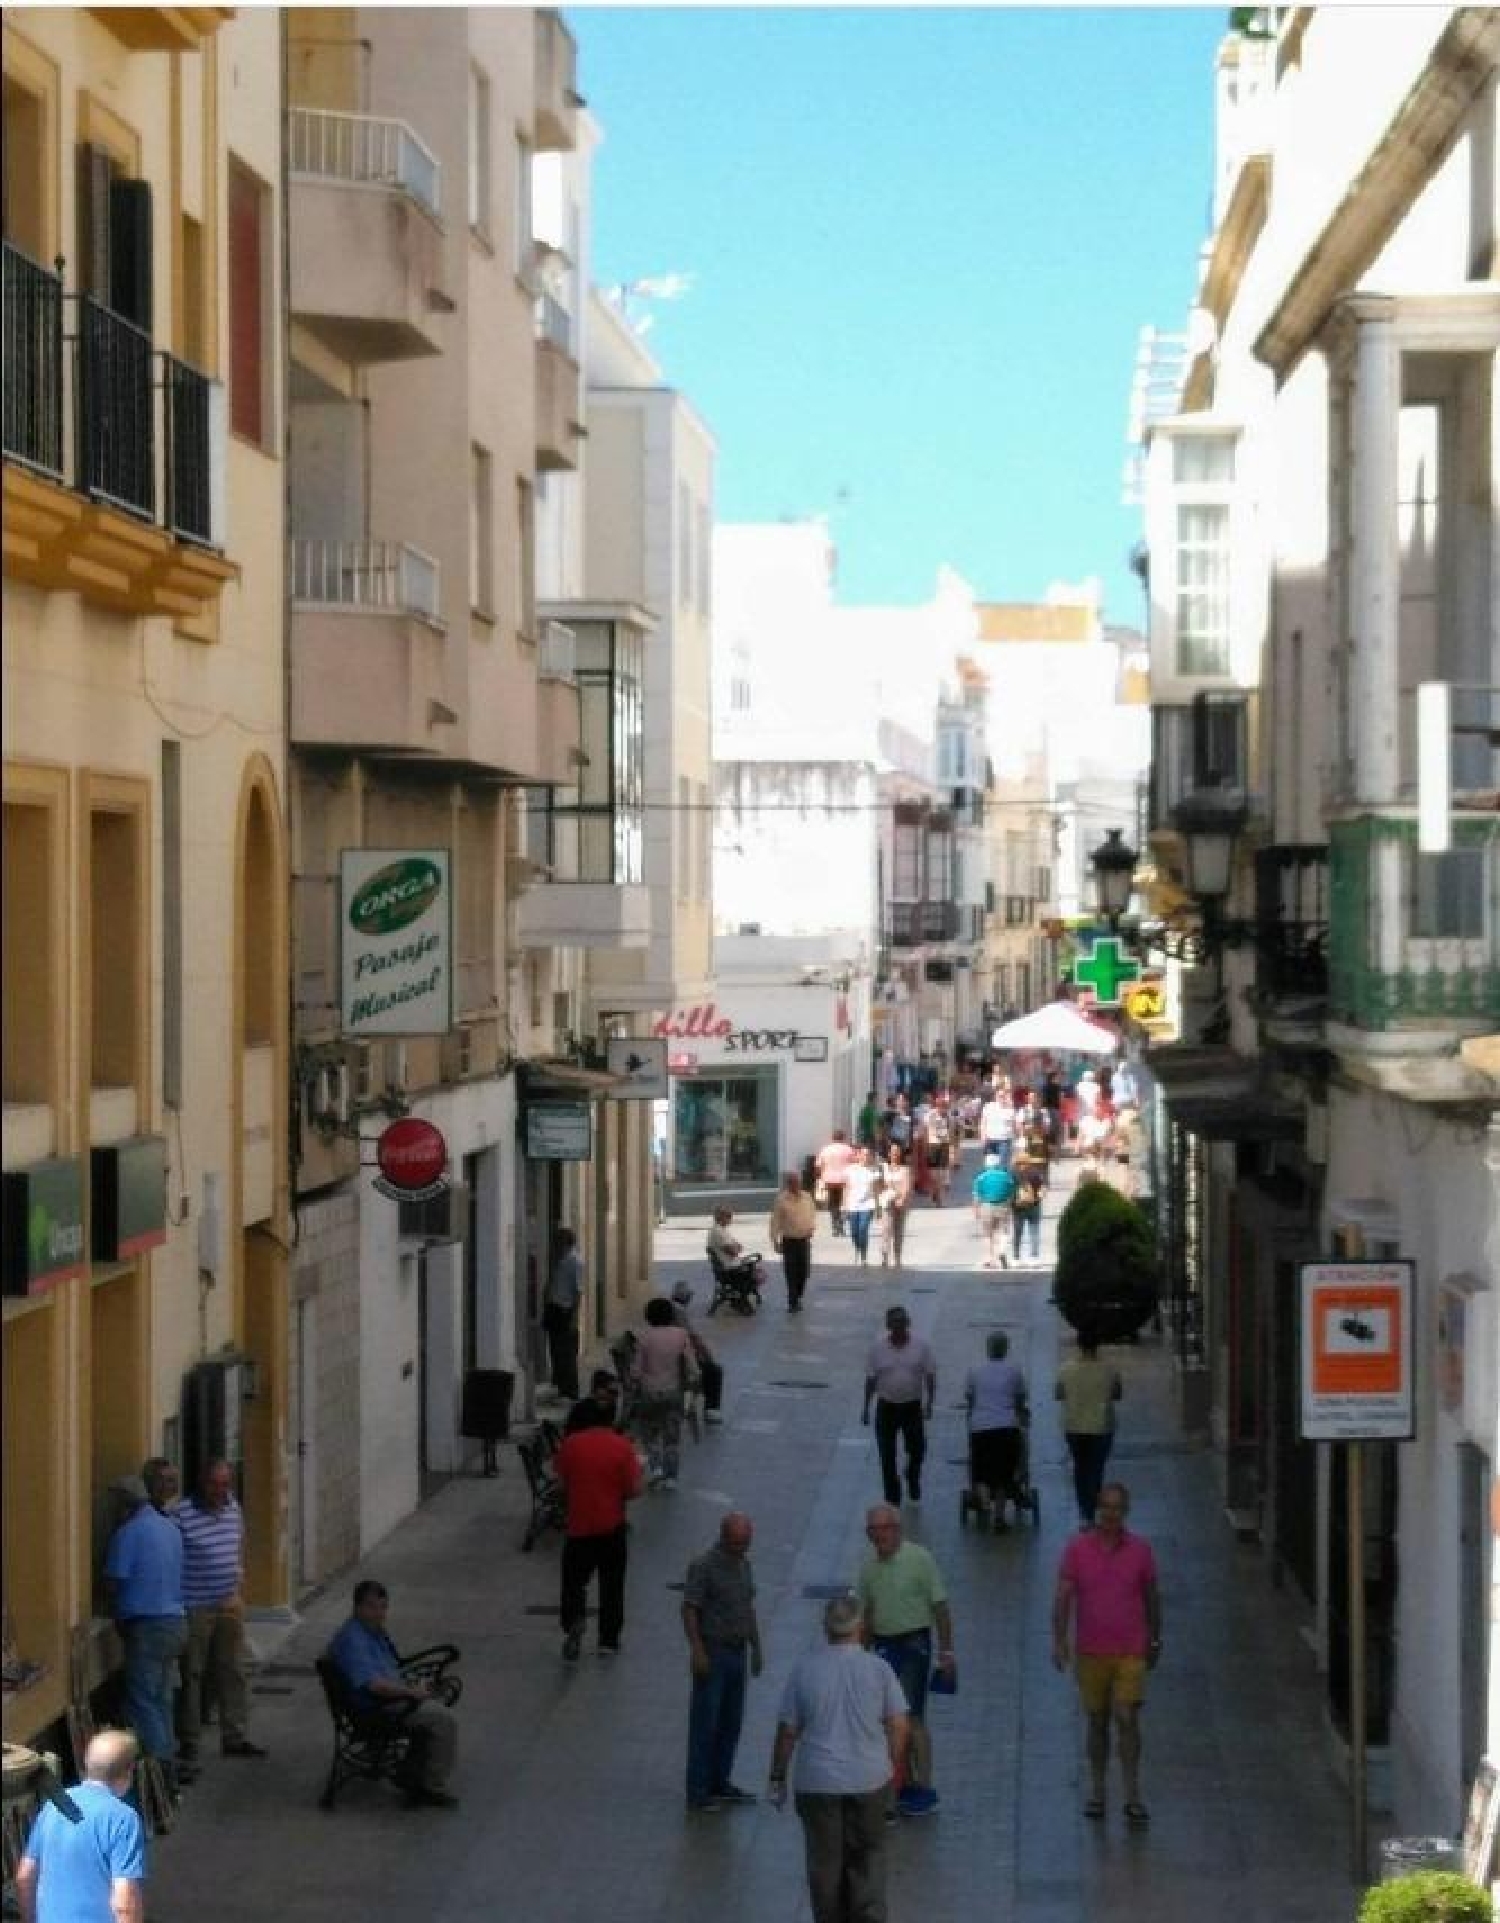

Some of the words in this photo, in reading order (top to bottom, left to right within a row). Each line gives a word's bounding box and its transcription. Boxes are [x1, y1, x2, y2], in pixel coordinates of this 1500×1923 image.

[359, 871, 436, 916] ORGA
[354, 930, 440, 982] Pasaje
[350, 965, 442, 1027] Musical
[724, 1028, 799, 1053] SPORT
